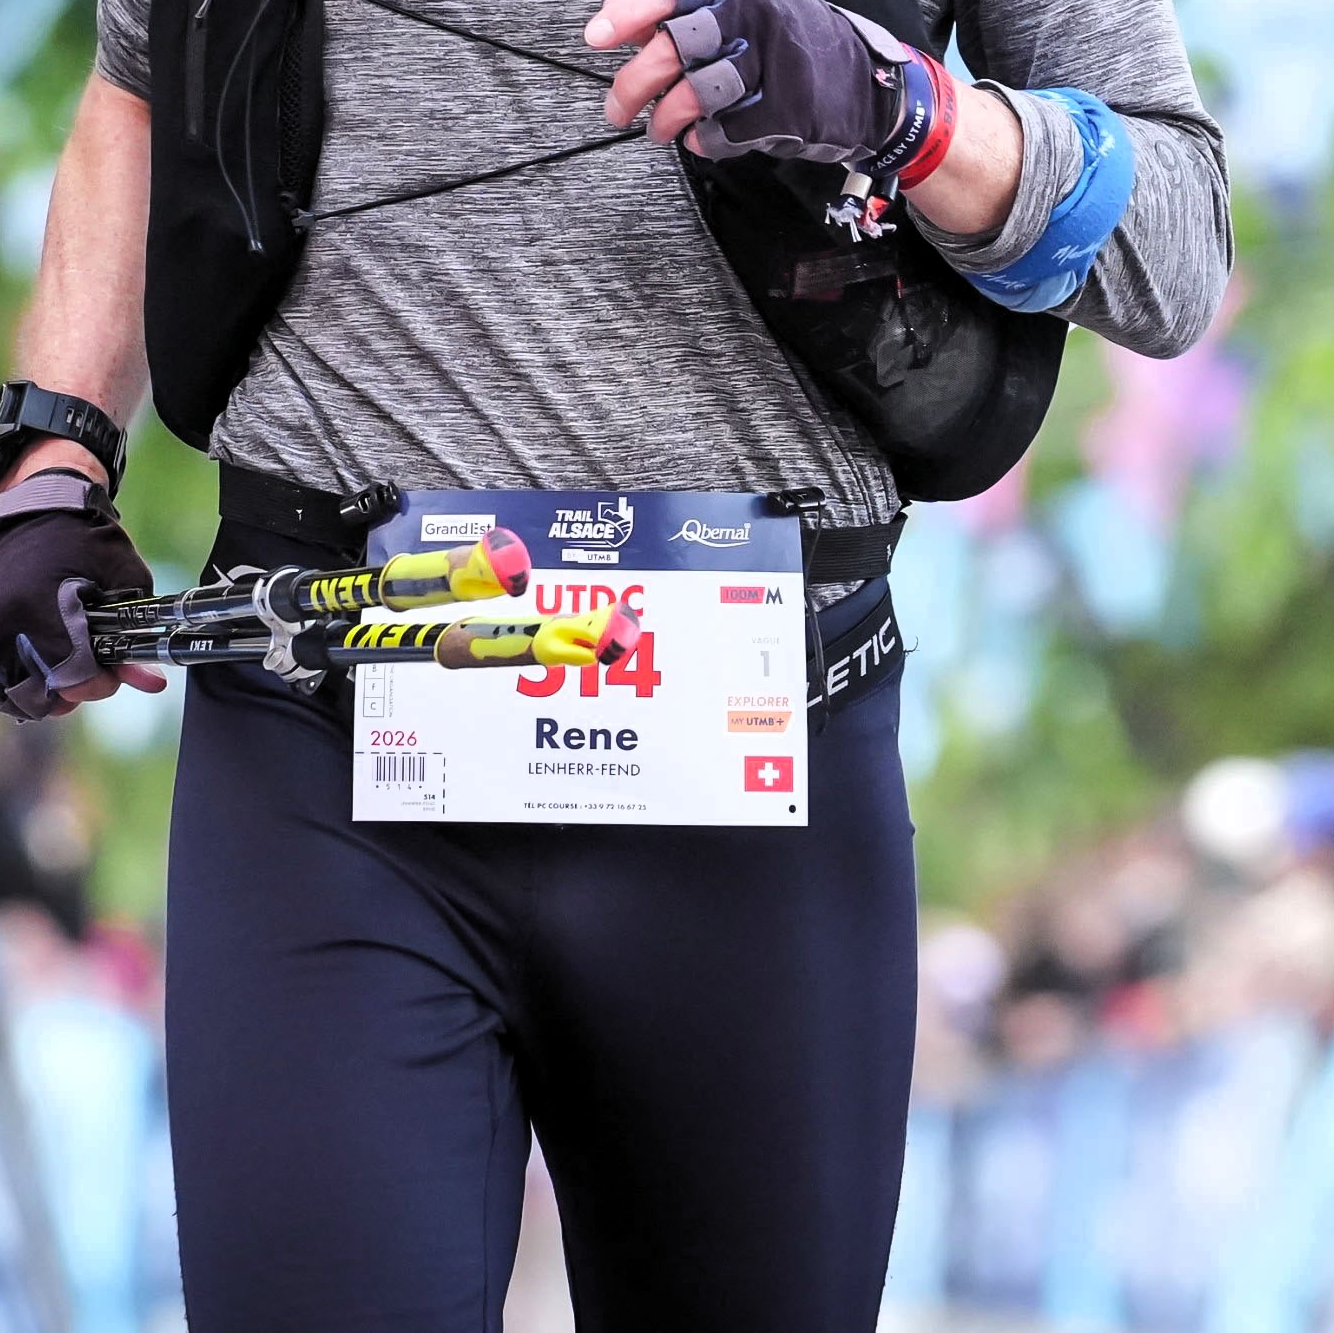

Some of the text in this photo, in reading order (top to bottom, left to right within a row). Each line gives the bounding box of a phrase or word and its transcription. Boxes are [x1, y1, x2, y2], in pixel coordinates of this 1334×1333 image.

[893, 142, 908, 155] BY
[555, 510, 593, 522] TRAIL
[548, 523, 615, 539] ALSACE
[587, 553, 611, 562] UTMB
[310, 573, 373, 612] LEKI
[765, 587, 783, 605] M
[535, 584, 644, 616] UTDC
[190, 639, 214, 651] LEKI
[751, 637, 780, 645] VAGUE
[760, 650, 770, 677] 1
[727, 696, 789, 707] EXPLORER
[370, 730, 418, 747] 2026
[535, 717, 639, 751] Rene
[528, 762, 641, 776] LENHERR-FEND
[548, 802, 578, 810] COURSE
